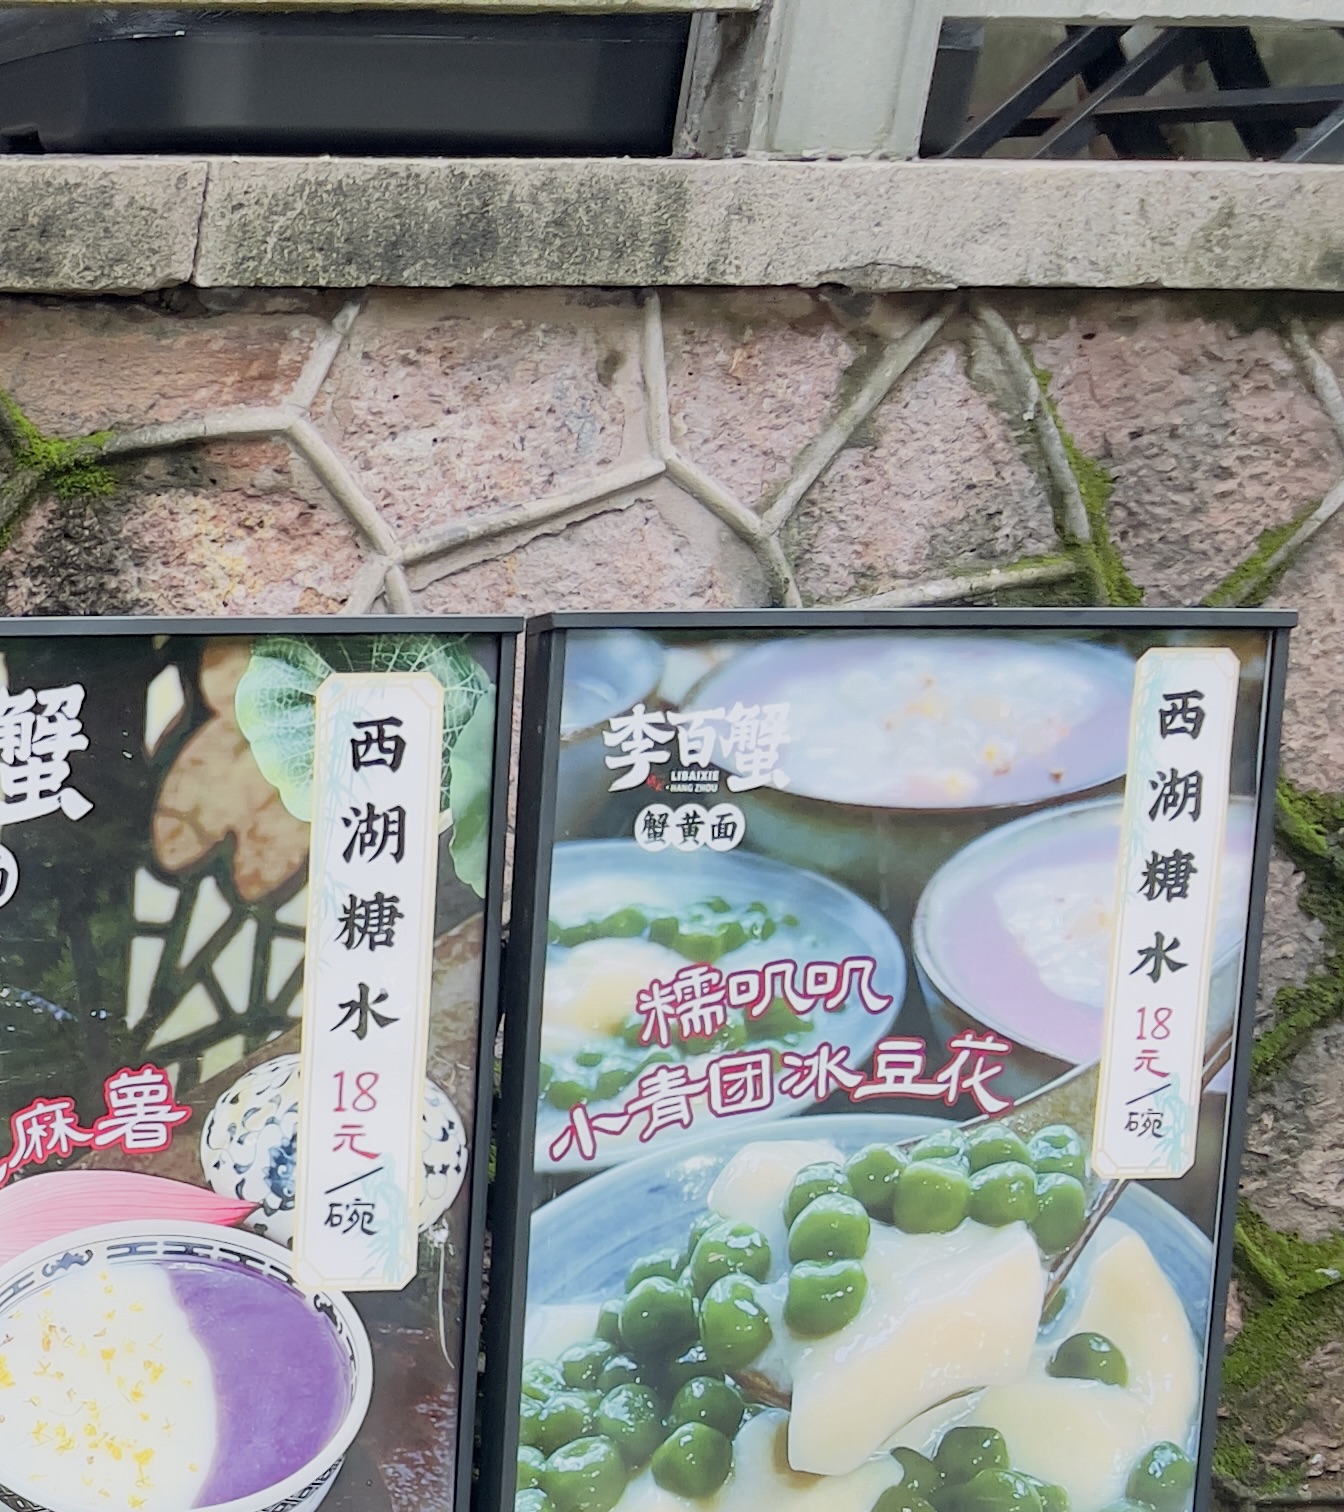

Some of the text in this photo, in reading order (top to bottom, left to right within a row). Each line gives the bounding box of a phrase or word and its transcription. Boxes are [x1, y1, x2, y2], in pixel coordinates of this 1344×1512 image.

[603, 701, 791, 792] 李百蟹
[330, 716, 407, 1042] 西湖糖水
[642, 809, 738, 845] 蟹黄面
[1130, 690, 1206, 983] 西湖糖水
[636, 956, 894, 1048] 糯叽叽
[549, 1027, 1011, 1163] 小青团冰豆花
